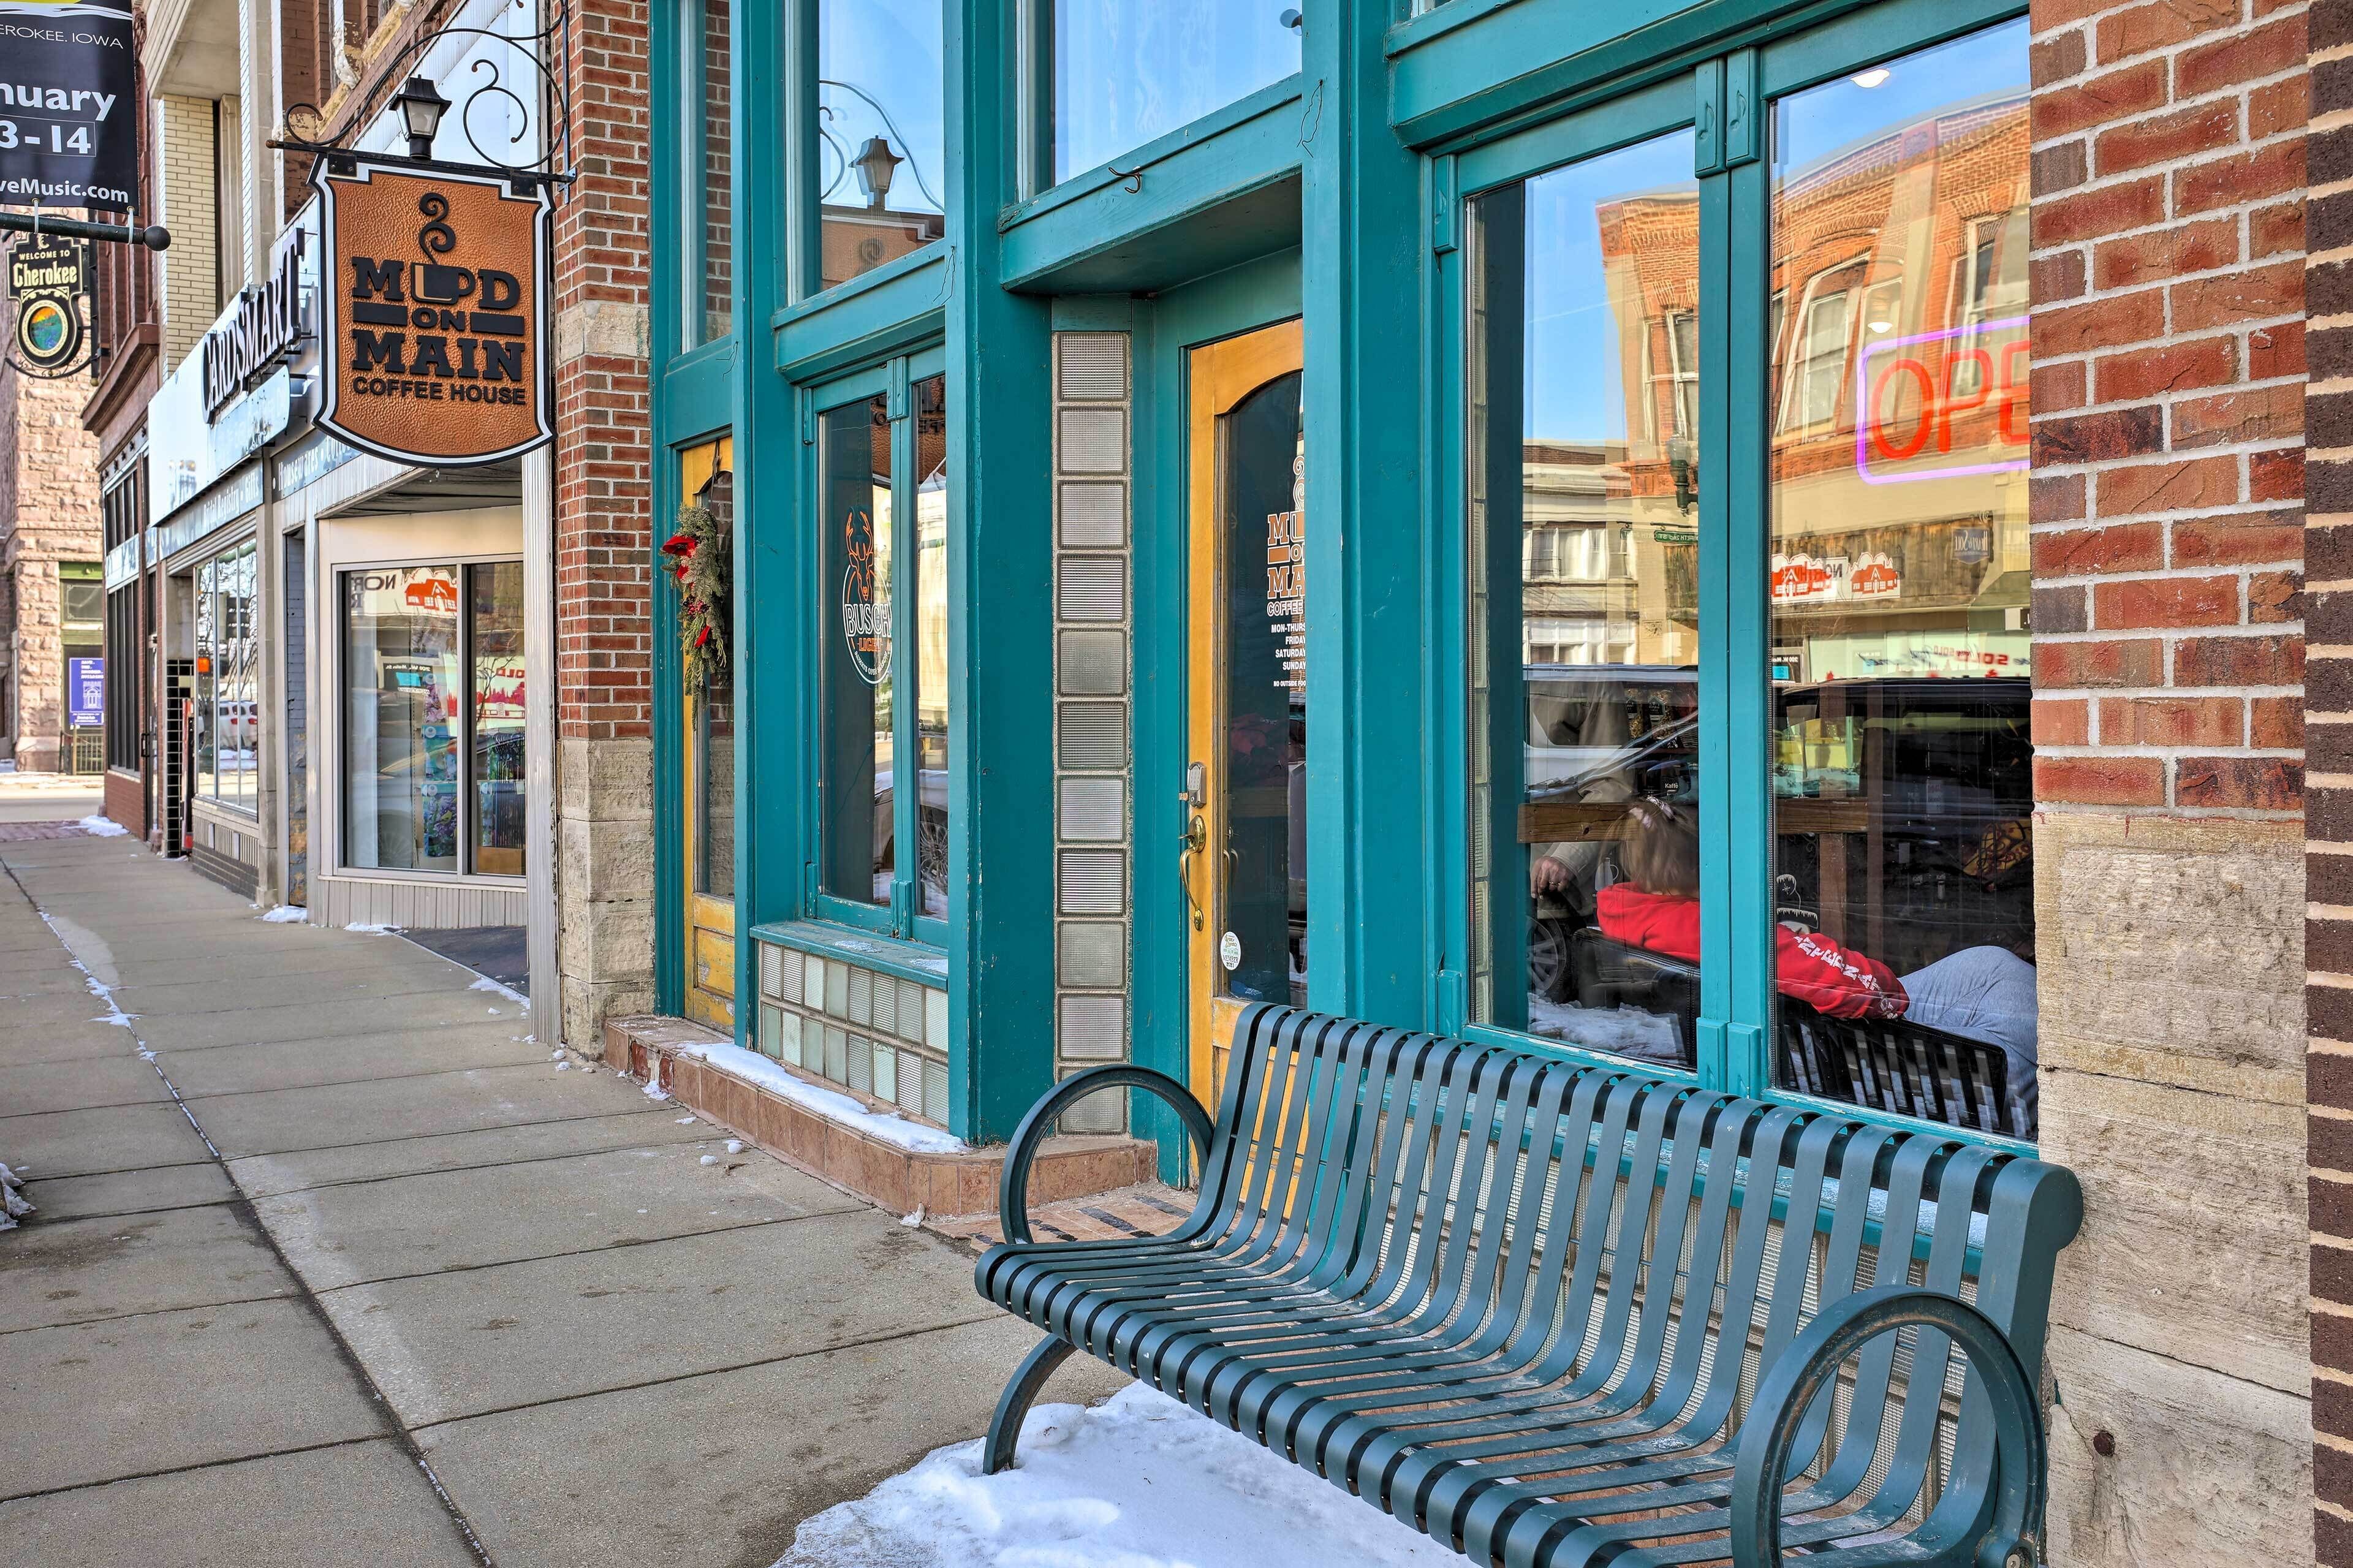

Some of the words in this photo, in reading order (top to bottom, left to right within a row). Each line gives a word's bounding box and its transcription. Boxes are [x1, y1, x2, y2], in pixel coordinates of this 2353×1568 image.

[72, 32, 123, 49] IOWA
[51, 125, 91, 154] 14
[19, 251, 57, 260] WELCOME
[13, 260, 77, 287] Cherokee
[202, 227, 305, 424] CARDSMART
[412, 307, 466, 331] ON
[352, 329, 526, 382] MAIN
[353, 376, 443, 400] COFFEE
[450, 383, 526, 405] HOUSE
[278, 446, 319, 491] Housewares
[845, 604, 892, 637] BUSCH
[1267, 599, 1304, 617] COFFEE
